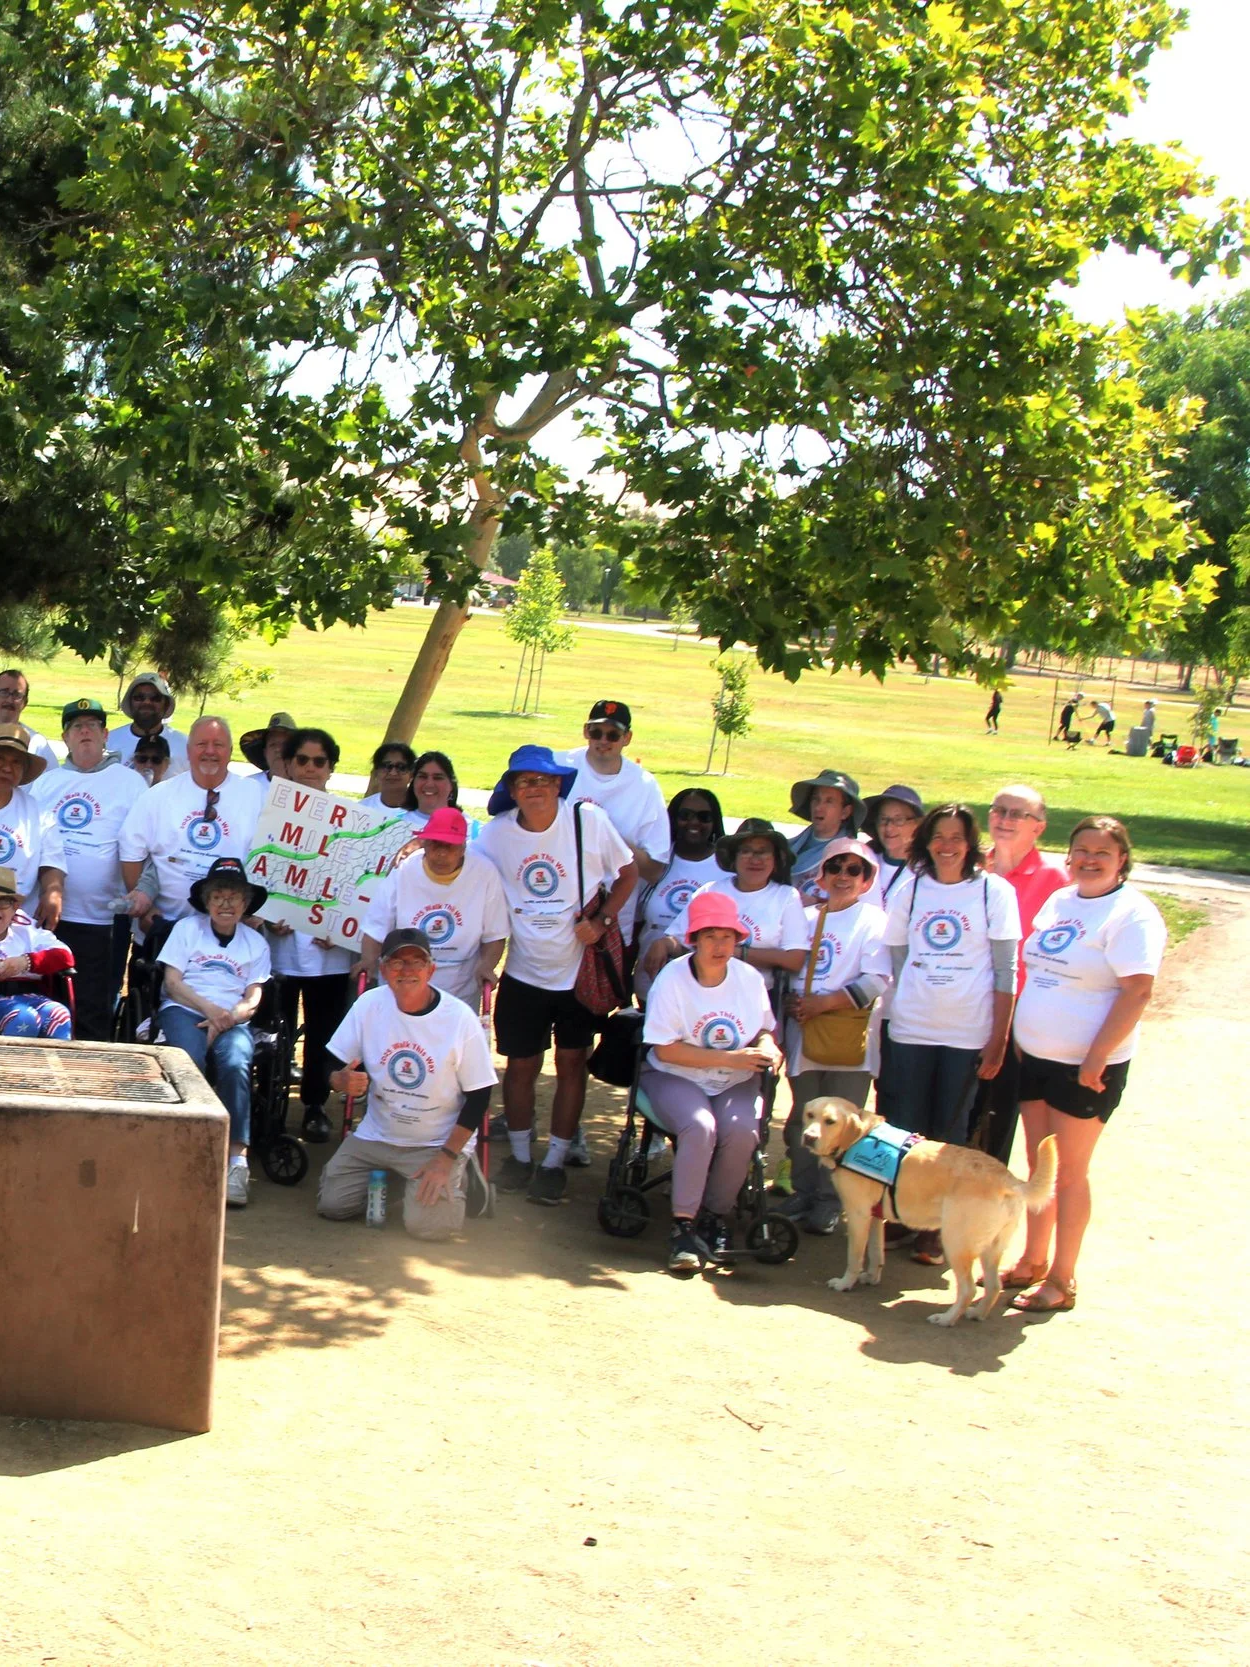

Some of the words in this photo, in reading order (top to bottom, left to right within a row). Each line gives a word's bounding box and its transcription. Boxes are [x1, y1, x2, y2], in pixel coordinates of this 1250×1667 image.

[272, 784, 370, 832] EVERY
[279, 822, 352, 865] MILE
[252, 855, 267, 876] A
[541, 854, 556, 865] This
[308, 904, 363, 943] STO
[425, 904, 442, 913] Walk
[453, 911, 463, 927] Way
[720, 1011, 735, 1021] This
[412, 1043, 427, 1057] This
[426, 1056, 434, 1074] Way
